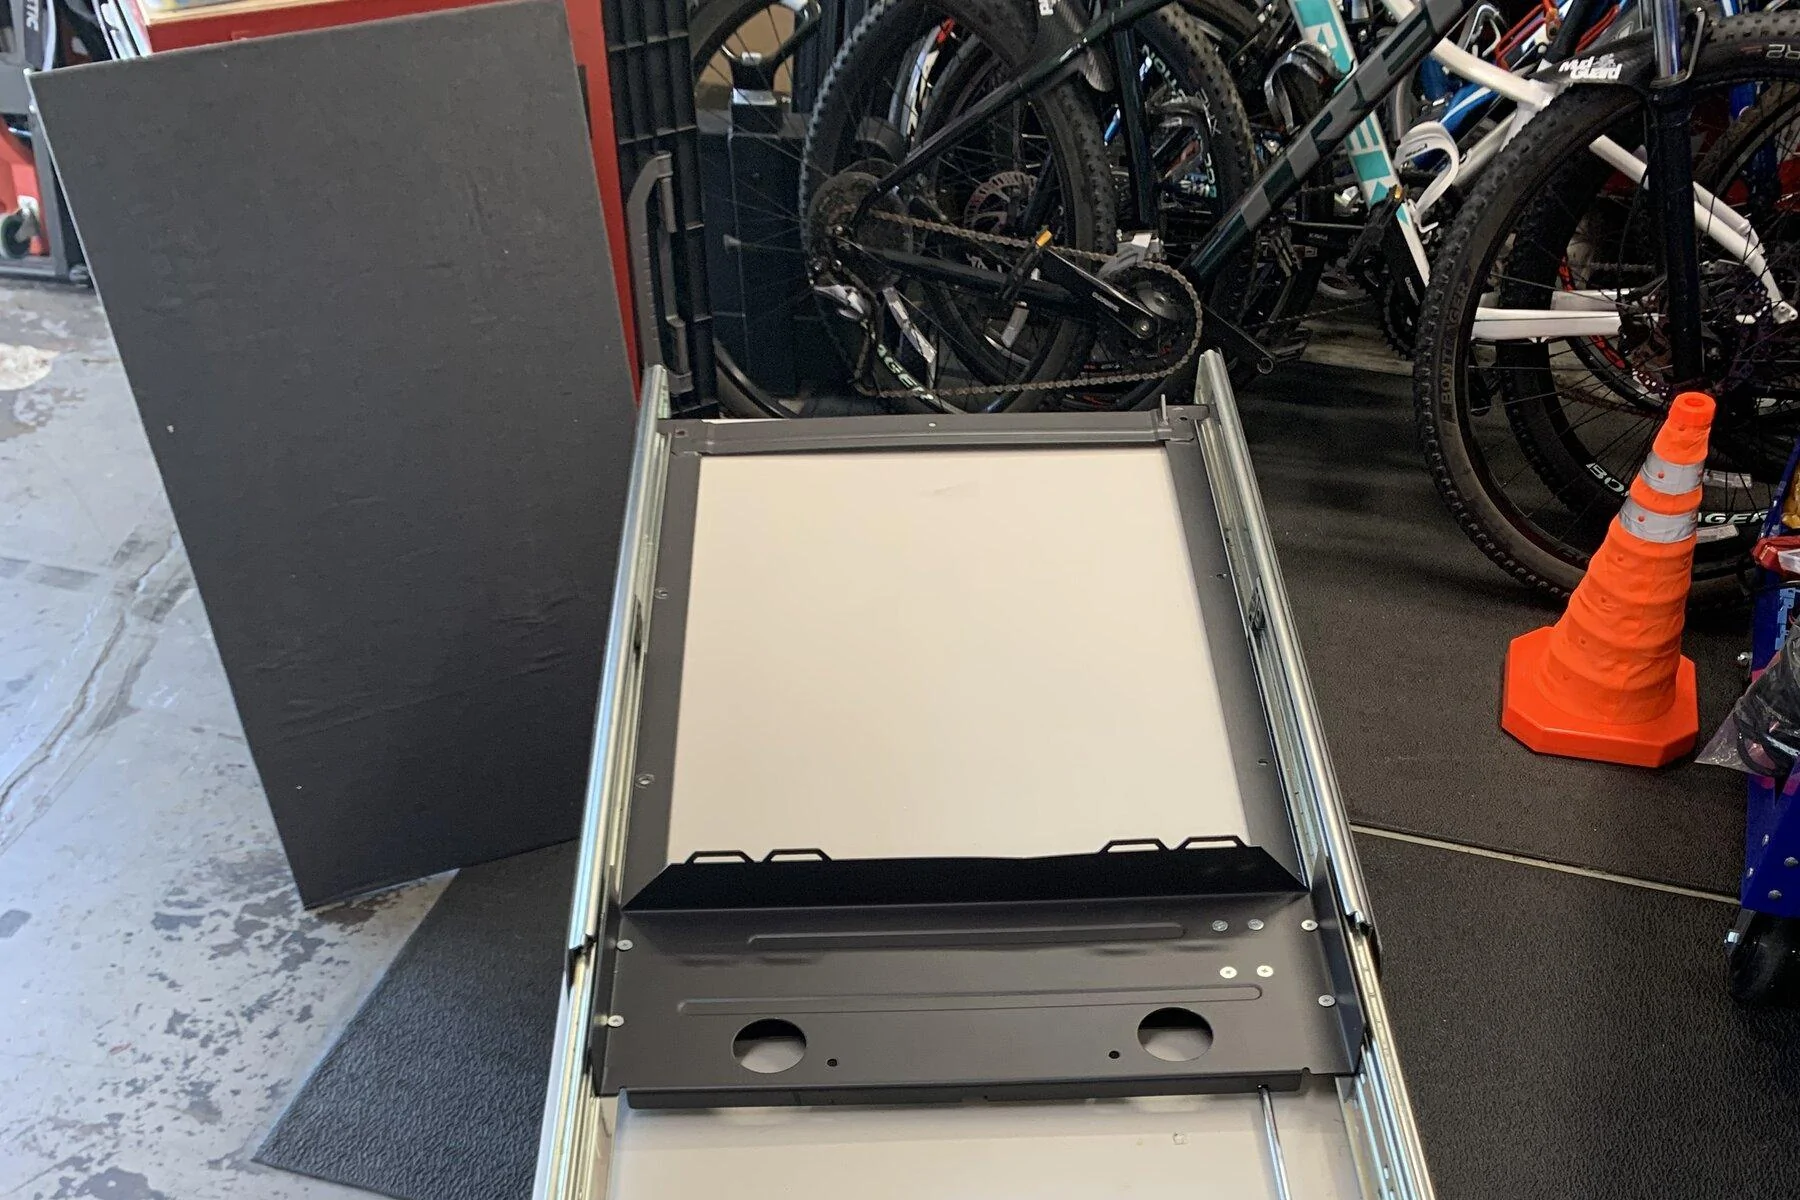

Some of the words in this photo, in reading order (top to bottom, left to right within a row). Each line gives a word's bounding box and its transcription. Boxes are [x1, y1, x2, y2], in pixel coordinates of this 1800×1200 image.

[1558, 55, 1596, 73] Mud
[1569, 63, 1623, 80] Guard
[1586, 462, 1629, 497] BO
